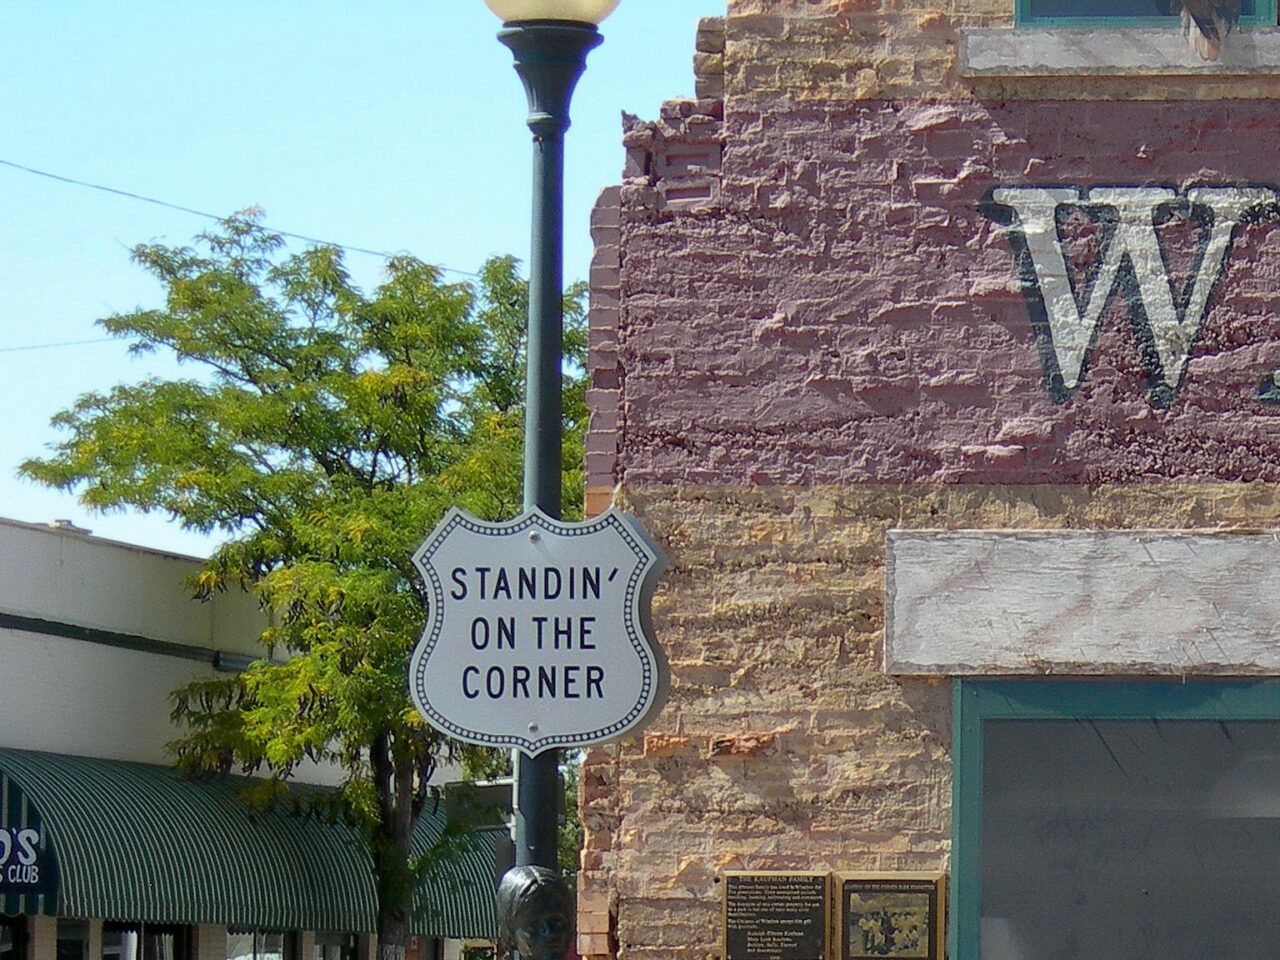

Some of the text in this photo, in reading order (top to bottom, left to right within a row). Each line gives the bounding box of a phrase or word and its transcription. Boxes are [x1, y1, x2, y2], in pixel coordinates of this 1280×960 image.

[450, 566, 620, 601] STANDIN'
[470, 616, 597, 651] ON THE
[462, 665, 605, 700] CORNER
[8, 864, 39, 884] CLUB
